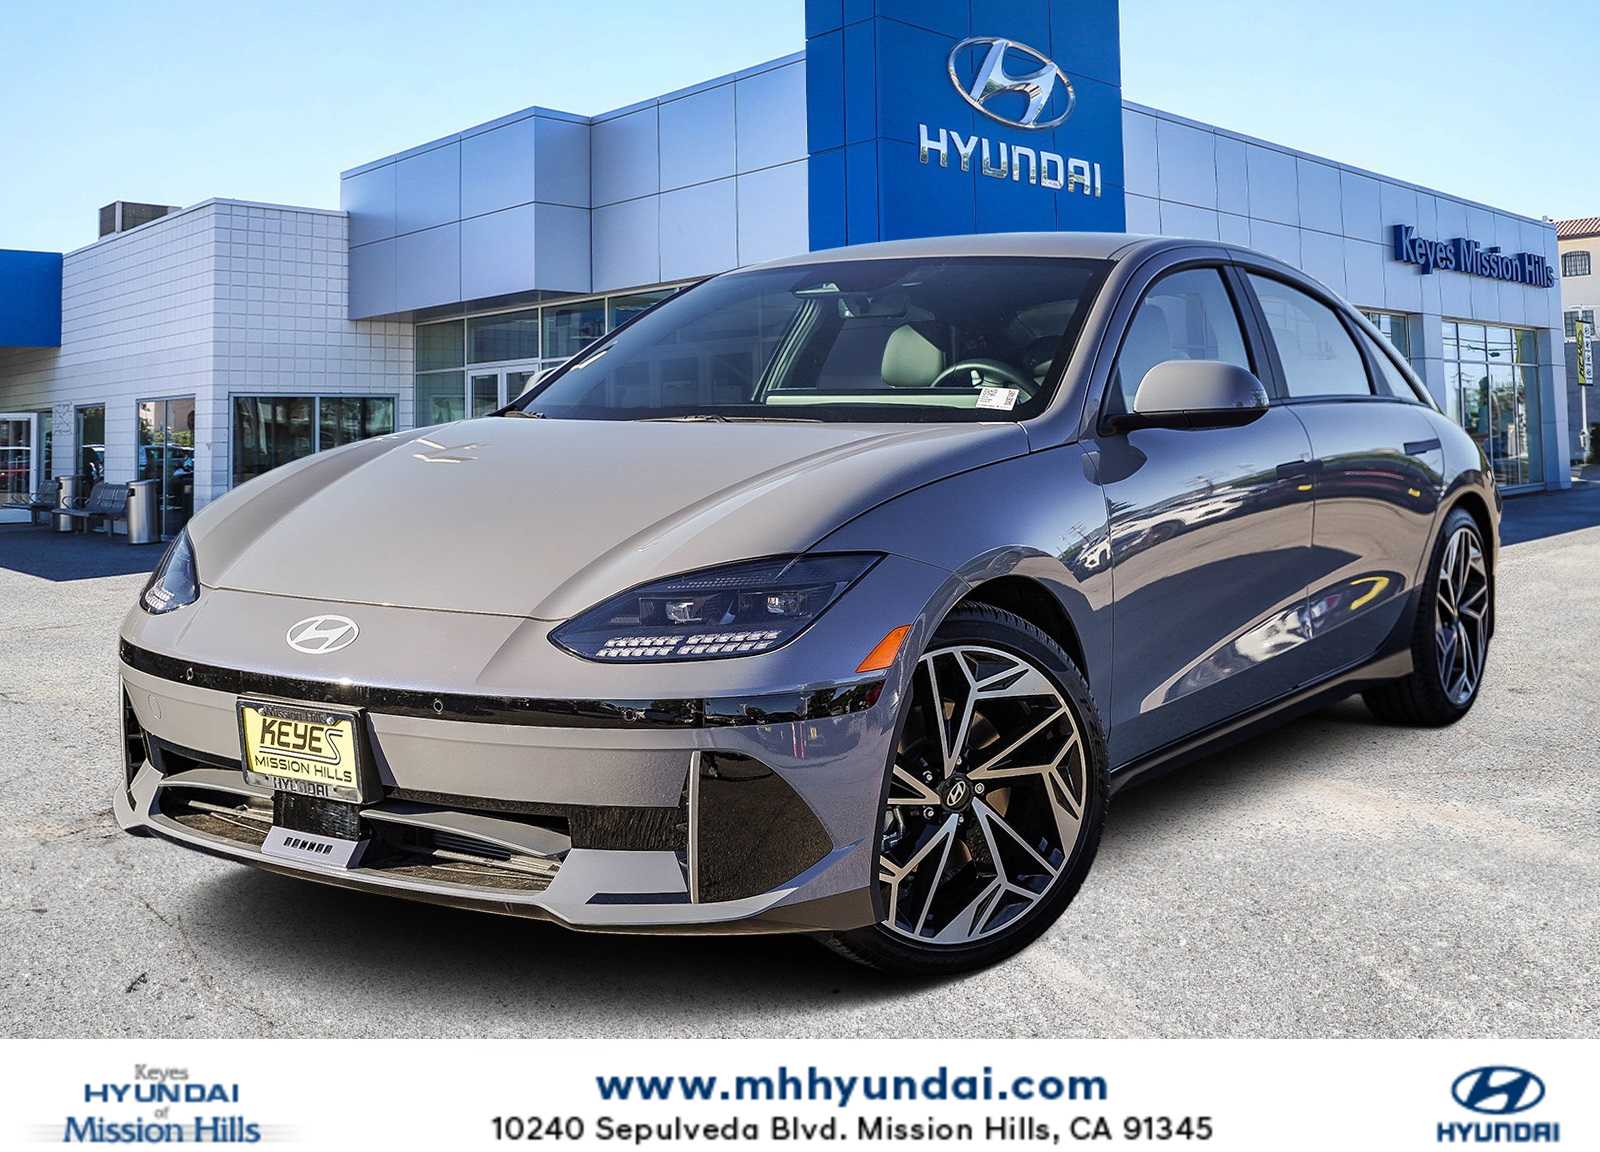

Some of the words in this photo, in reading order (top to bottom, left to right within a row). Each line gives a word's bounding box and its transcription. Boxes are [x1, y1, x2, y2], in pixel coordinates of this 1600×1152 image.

[919, 124, 1102, 198] HYUNDAI
[1395, 225, 1456, 274] Keyes
[1454, 238, 1522, 282] Mission
[1521, 252, 1555, 288] Hills
[254, 755, 310, 775] MISSION
[314, 764, 352, 783] HILLS
[259, 718, 344, 765] KEYES
